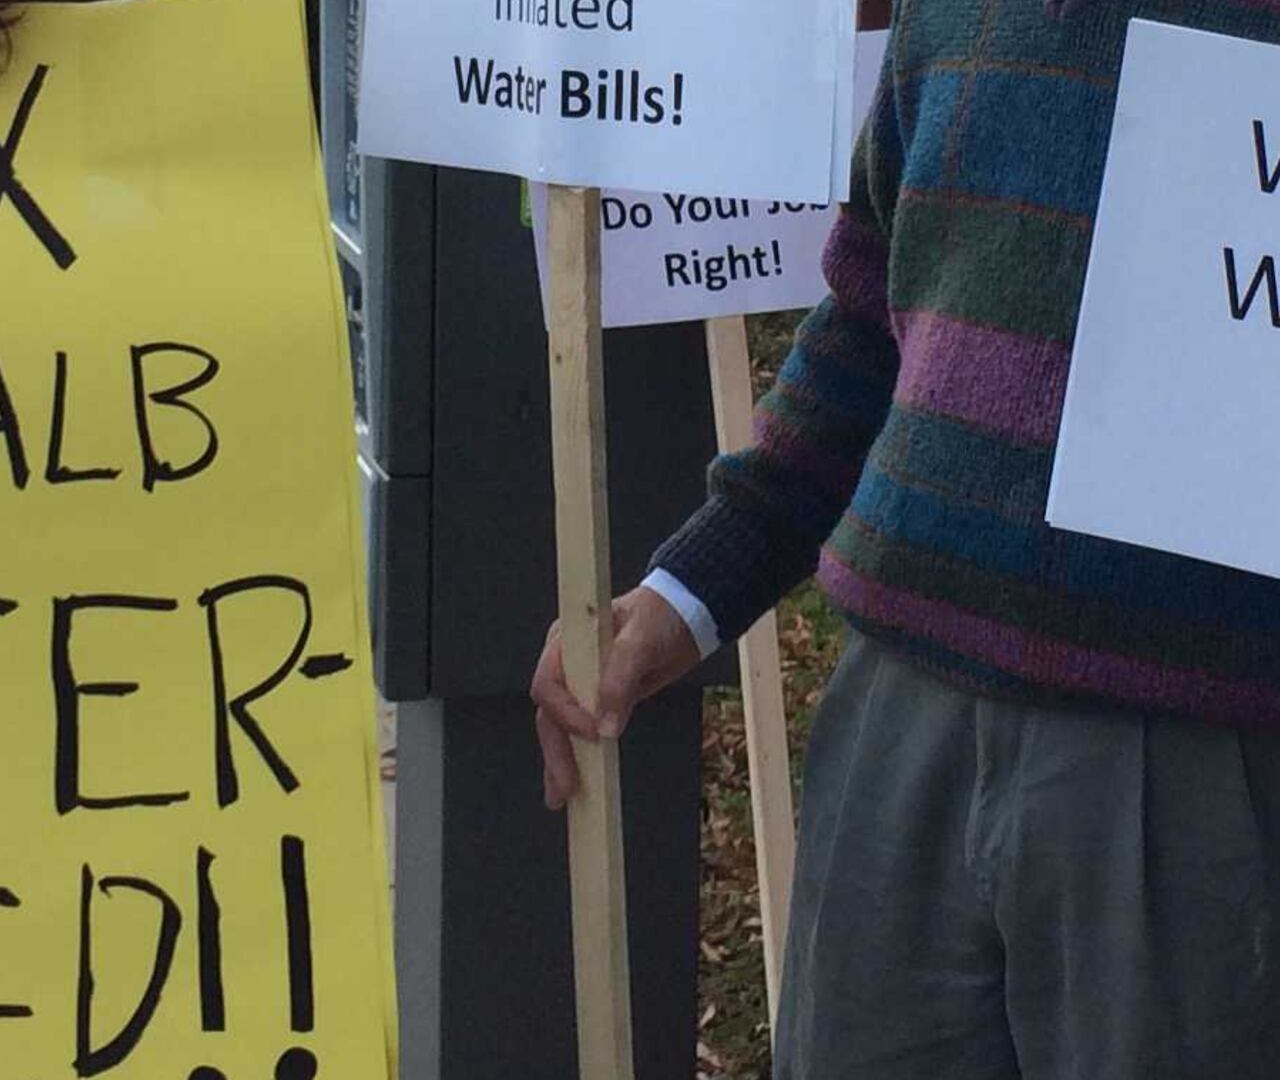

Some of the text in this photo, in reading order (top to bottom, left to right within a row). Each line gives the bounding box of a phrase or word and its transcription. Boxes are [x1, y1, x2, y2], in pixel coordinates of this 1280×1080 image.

[454, 56, 683, 125] Water Bills!
[601, 198, 652, 229] Do
[665, 240, 782, 291] Right!
